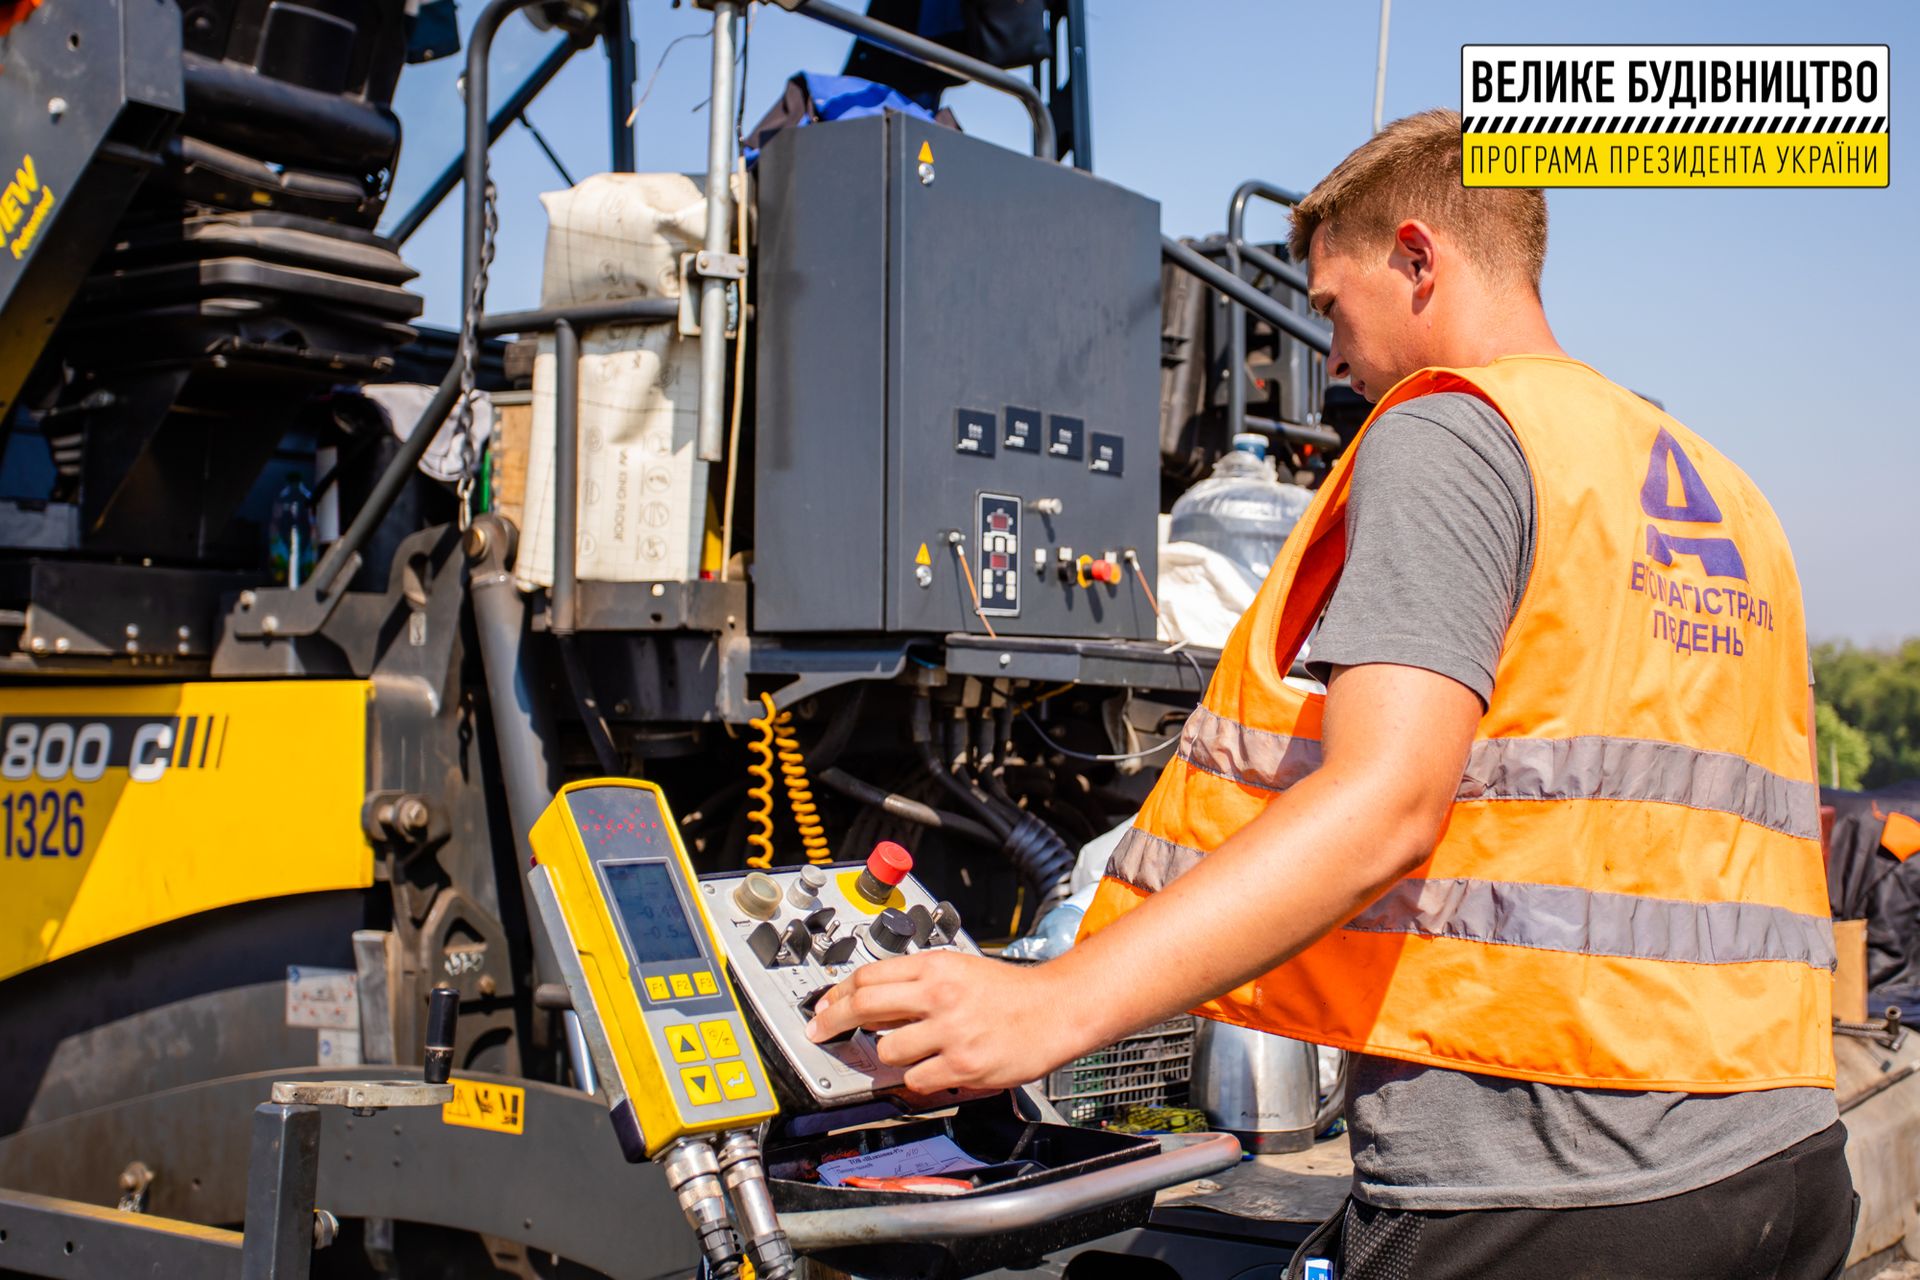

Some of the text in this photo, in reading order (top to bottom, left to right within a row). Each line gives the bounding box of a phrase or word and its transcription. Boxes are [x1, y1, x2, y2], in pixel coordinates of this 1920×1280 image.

[1, 722, 174, 782] 800 C
[2, 789, 84, 858] 1326
[651, 977, 713, 993] F1 F2 F3
